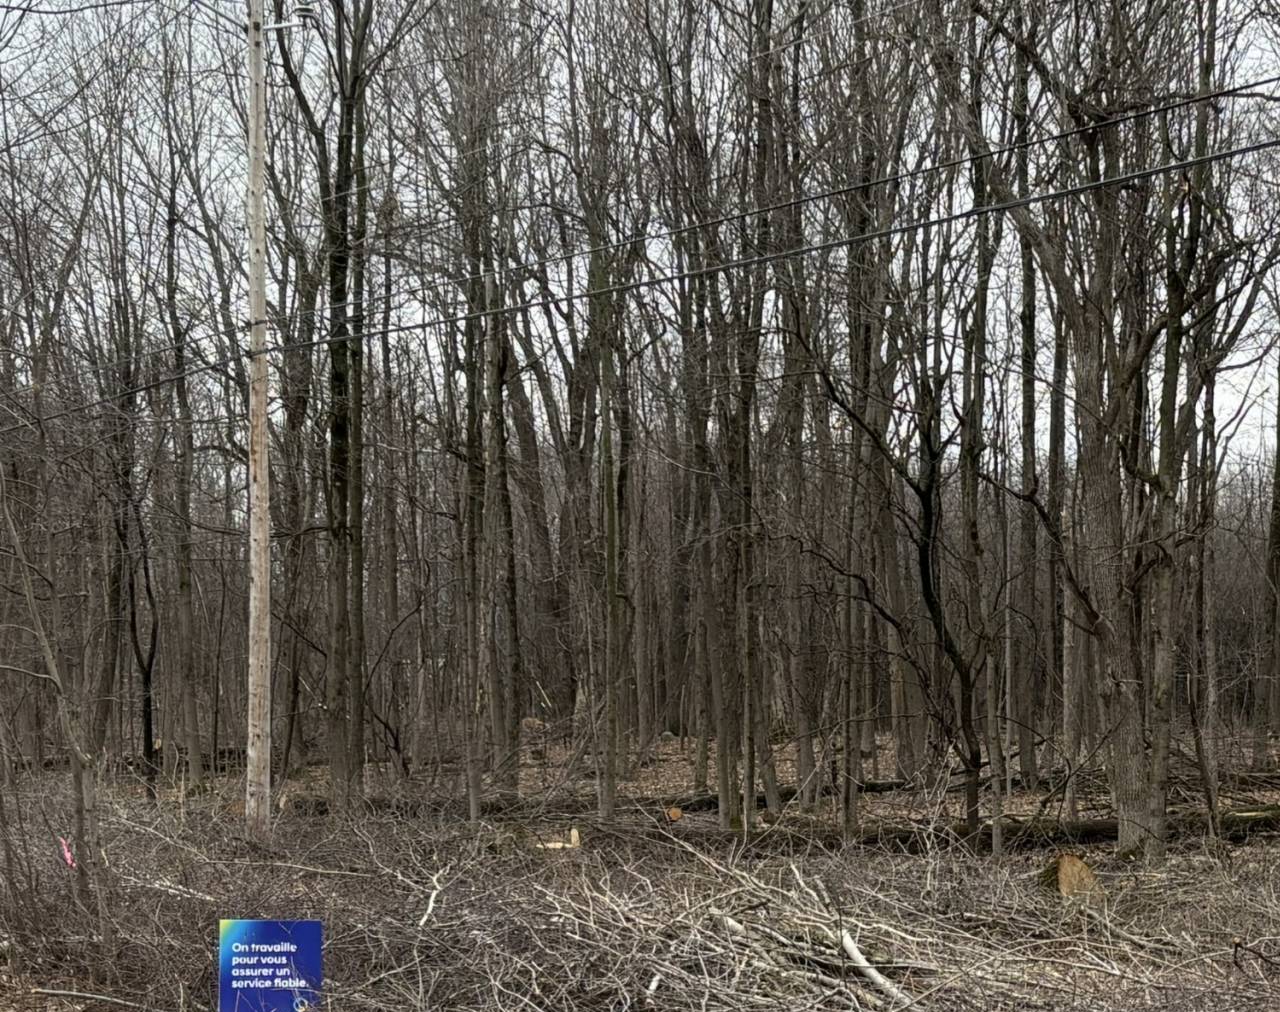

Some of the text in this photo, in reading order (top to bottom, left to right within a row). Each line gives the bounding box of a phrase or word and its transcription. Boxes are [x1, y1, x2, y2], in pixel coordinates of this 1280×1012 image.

[231, 942, 297, 952] On travaille
[231, 956, 287, 966] pour vous
[231, 967, 290, 976] assurer un
[231, 978, 309, 988] service fiable.
